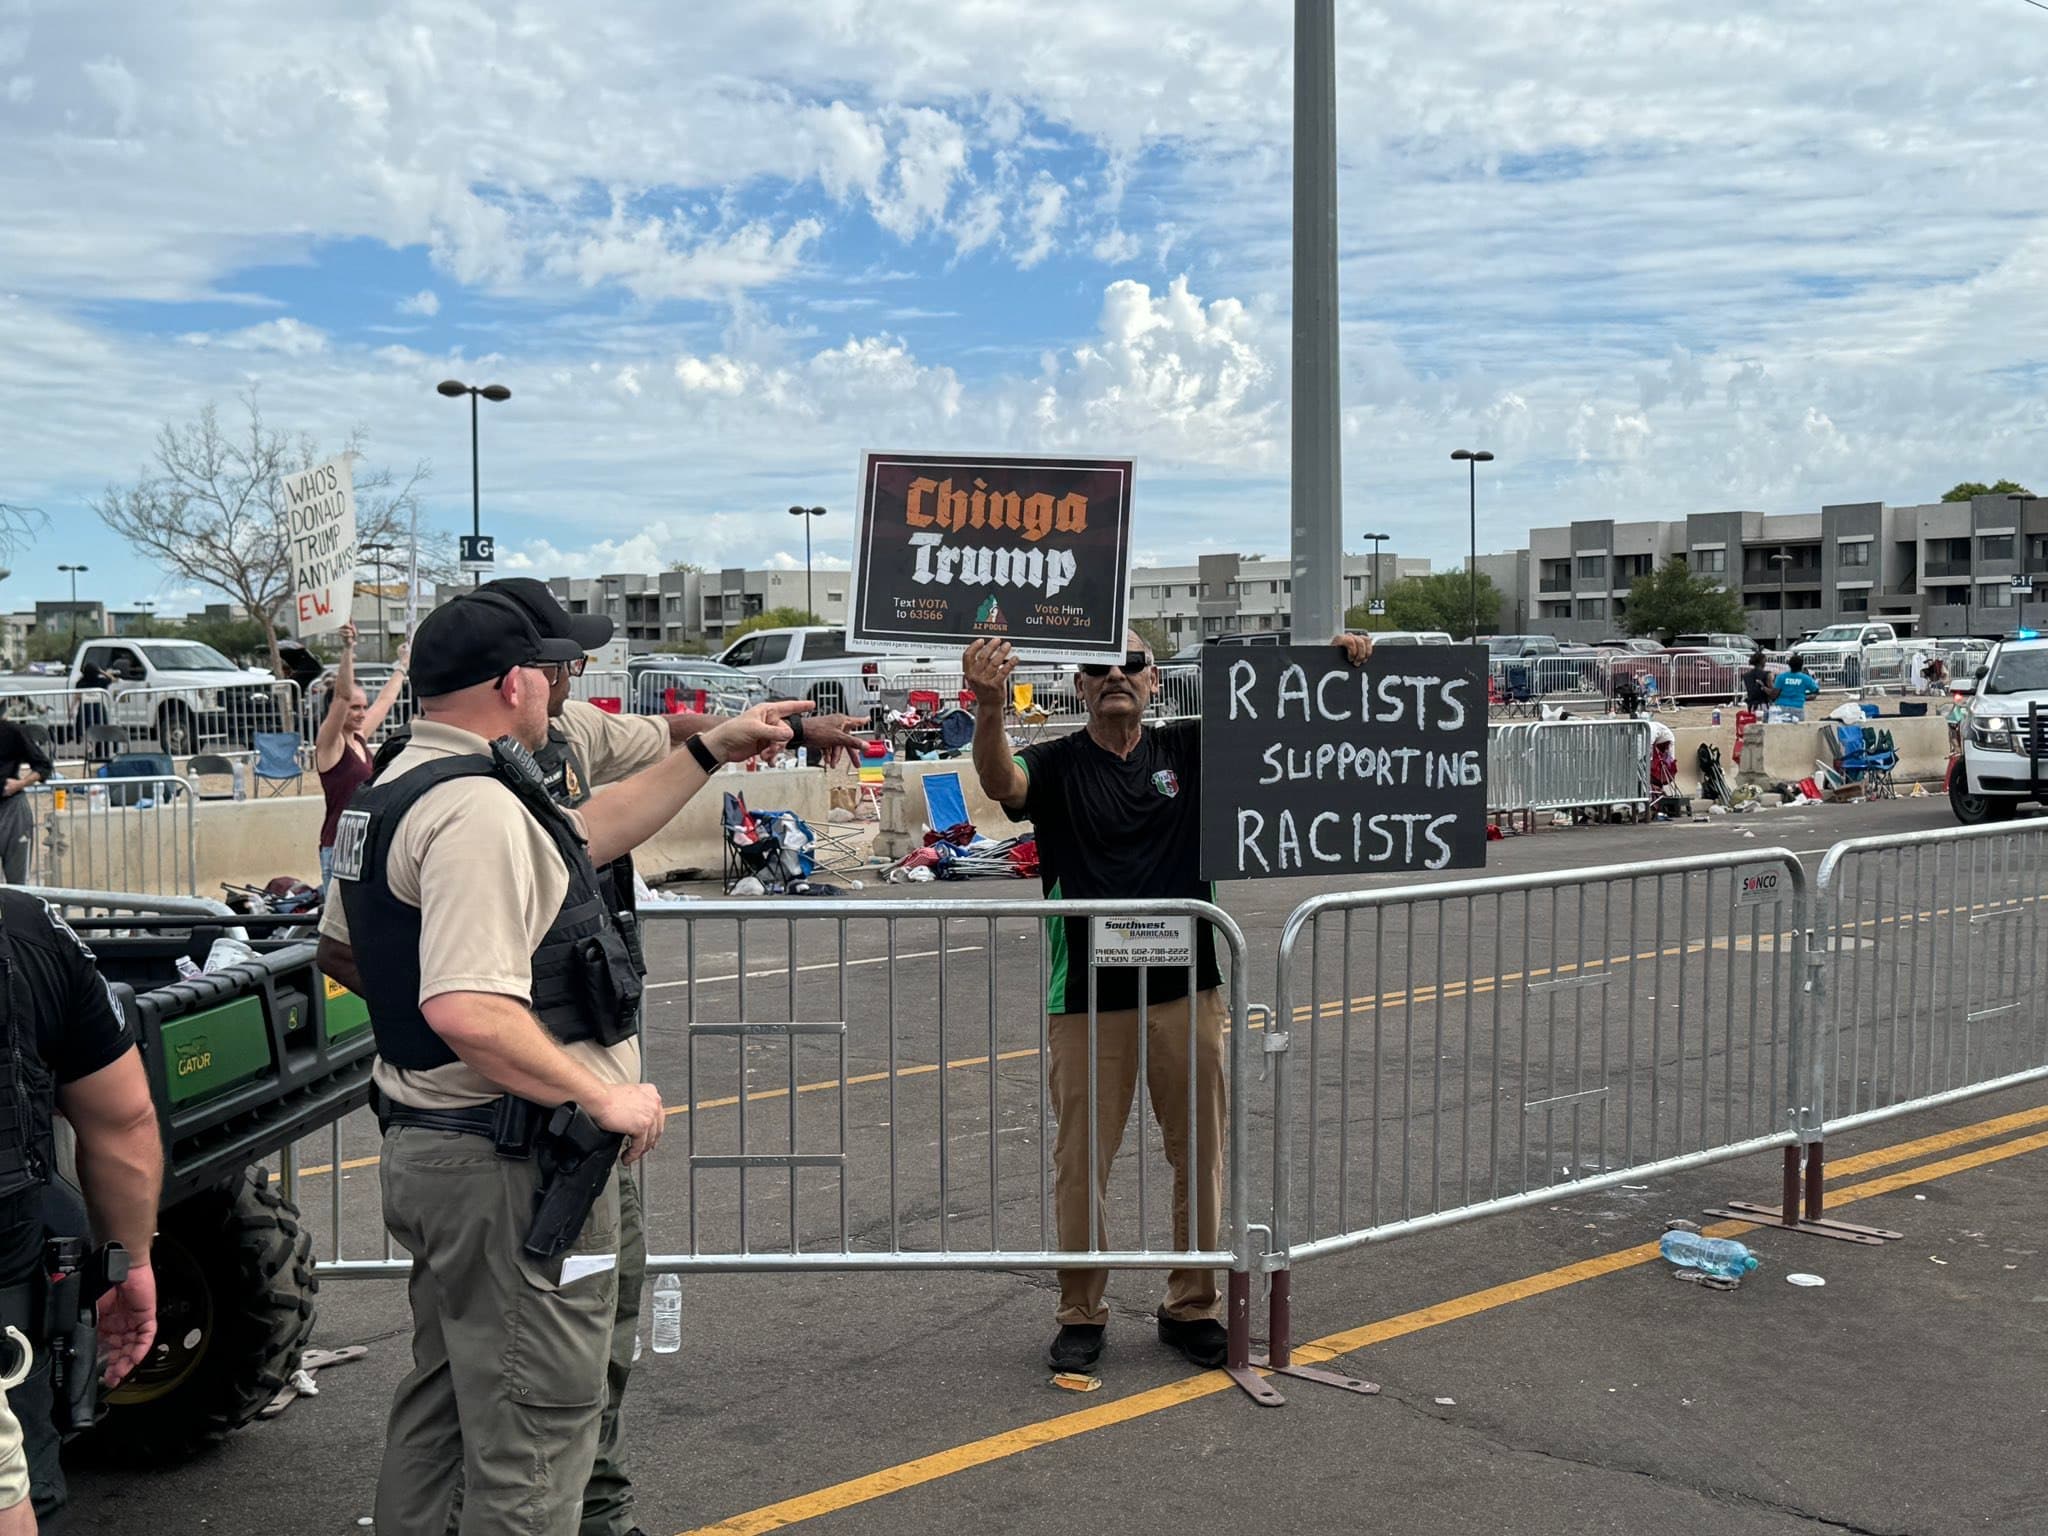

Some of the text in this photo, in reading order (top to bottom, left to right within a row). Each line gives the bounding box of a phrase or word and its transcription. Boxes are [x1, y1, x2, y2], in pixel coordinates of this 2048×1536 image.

[287, 465, 338, 505] WHO'S
[291, 490, 346, 536] DONALD
[906, 476, 1089, 542] Chinga
[294, 524, 341, 563] TRUMP
[908, 532, 1078, 599] Trump
[299, 588, 334, 623] EW.
[893, 597, 948, 609] Text VOTA
[896, 609, 944, 620] to 63566
[1025, 615, 1091, 627] out NOV 3rd
[1035, 604, 1084, 616] Vote Him
[1229, 660, 1469, 731] RACISTS
[1259, 742, 1482, 789] SUPPORTING
[1238, 807, 1458, 873] RACISTS
[1743, 875, 1777, 890] SONCO
[1104, 921, 1167, 930] Southwest
[178, 1052, 211, 1076] GATOR
